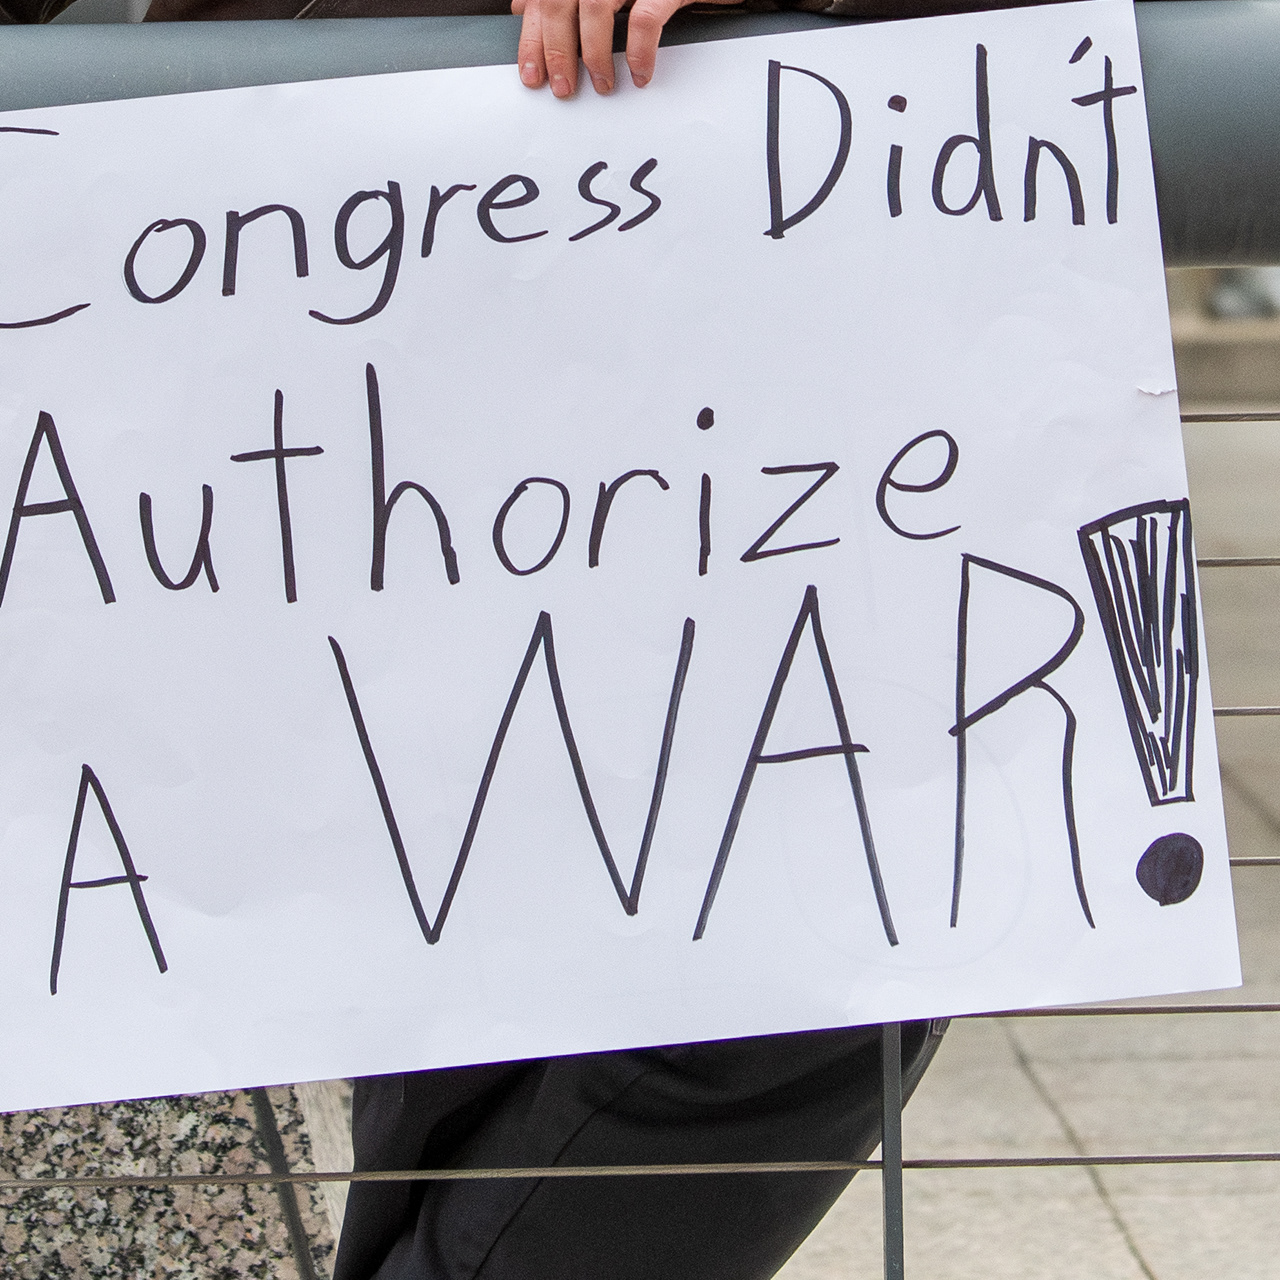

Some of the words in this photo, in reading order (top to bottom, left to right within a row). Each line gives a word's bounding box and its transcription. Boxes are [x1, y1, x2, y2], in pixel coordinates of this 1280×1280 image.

[764, 37, 1138, 239] Didn't
[50, 764, 167, 995] A
[328, 498, 1203, 946] WAR!
